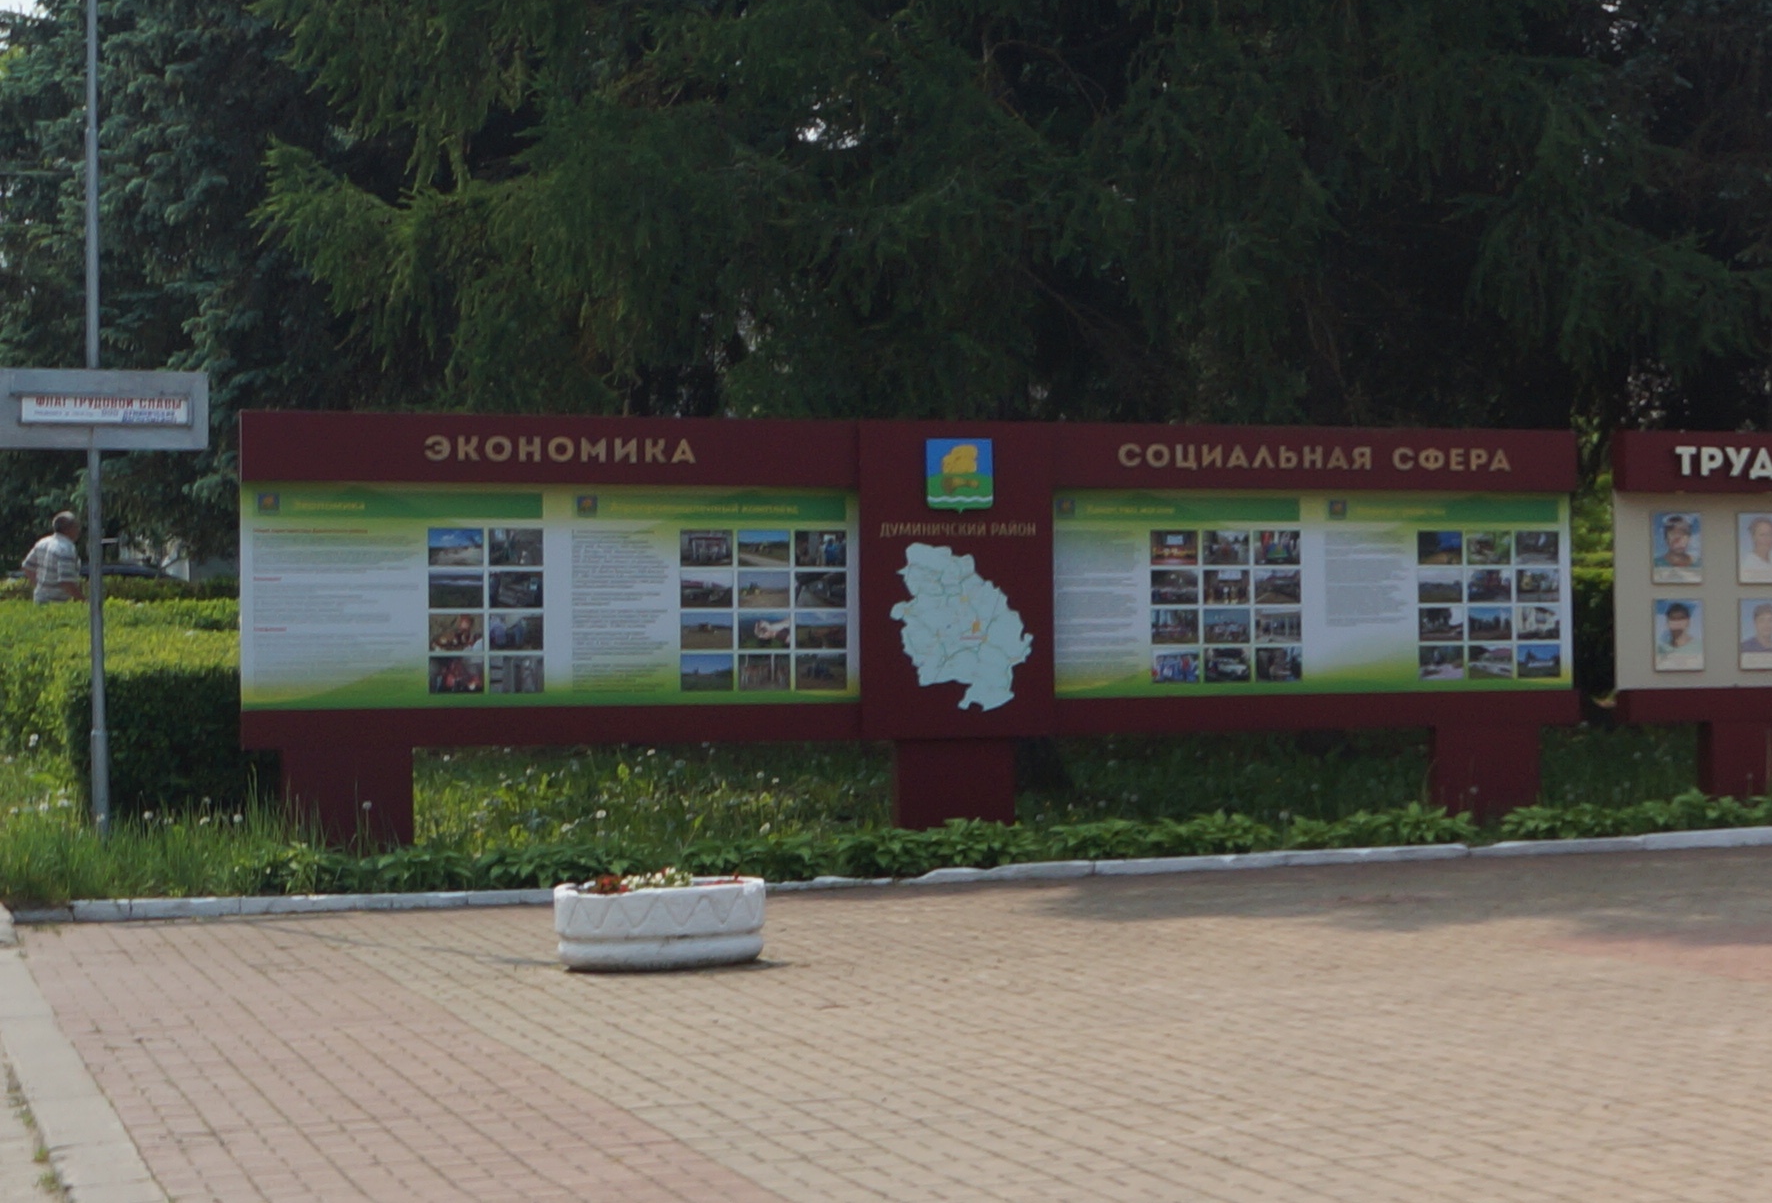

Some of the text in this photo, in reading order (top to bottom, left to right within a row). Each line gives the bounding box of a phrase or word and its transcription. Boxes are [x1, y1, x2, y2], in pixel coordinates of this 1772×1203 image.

[35, 397, 182, 410] ФЛАГ ТРУДОВОЙ СЛАВЫ
[423, 434, 697, 465] ЭКОНОМИКА
[1117, 442, 1512, 473] СОЦИАЛЬНАЯ СФЕРА
[879, 521, 1037, 538] ДУМИНИЧСКИЙ РАЙОН
